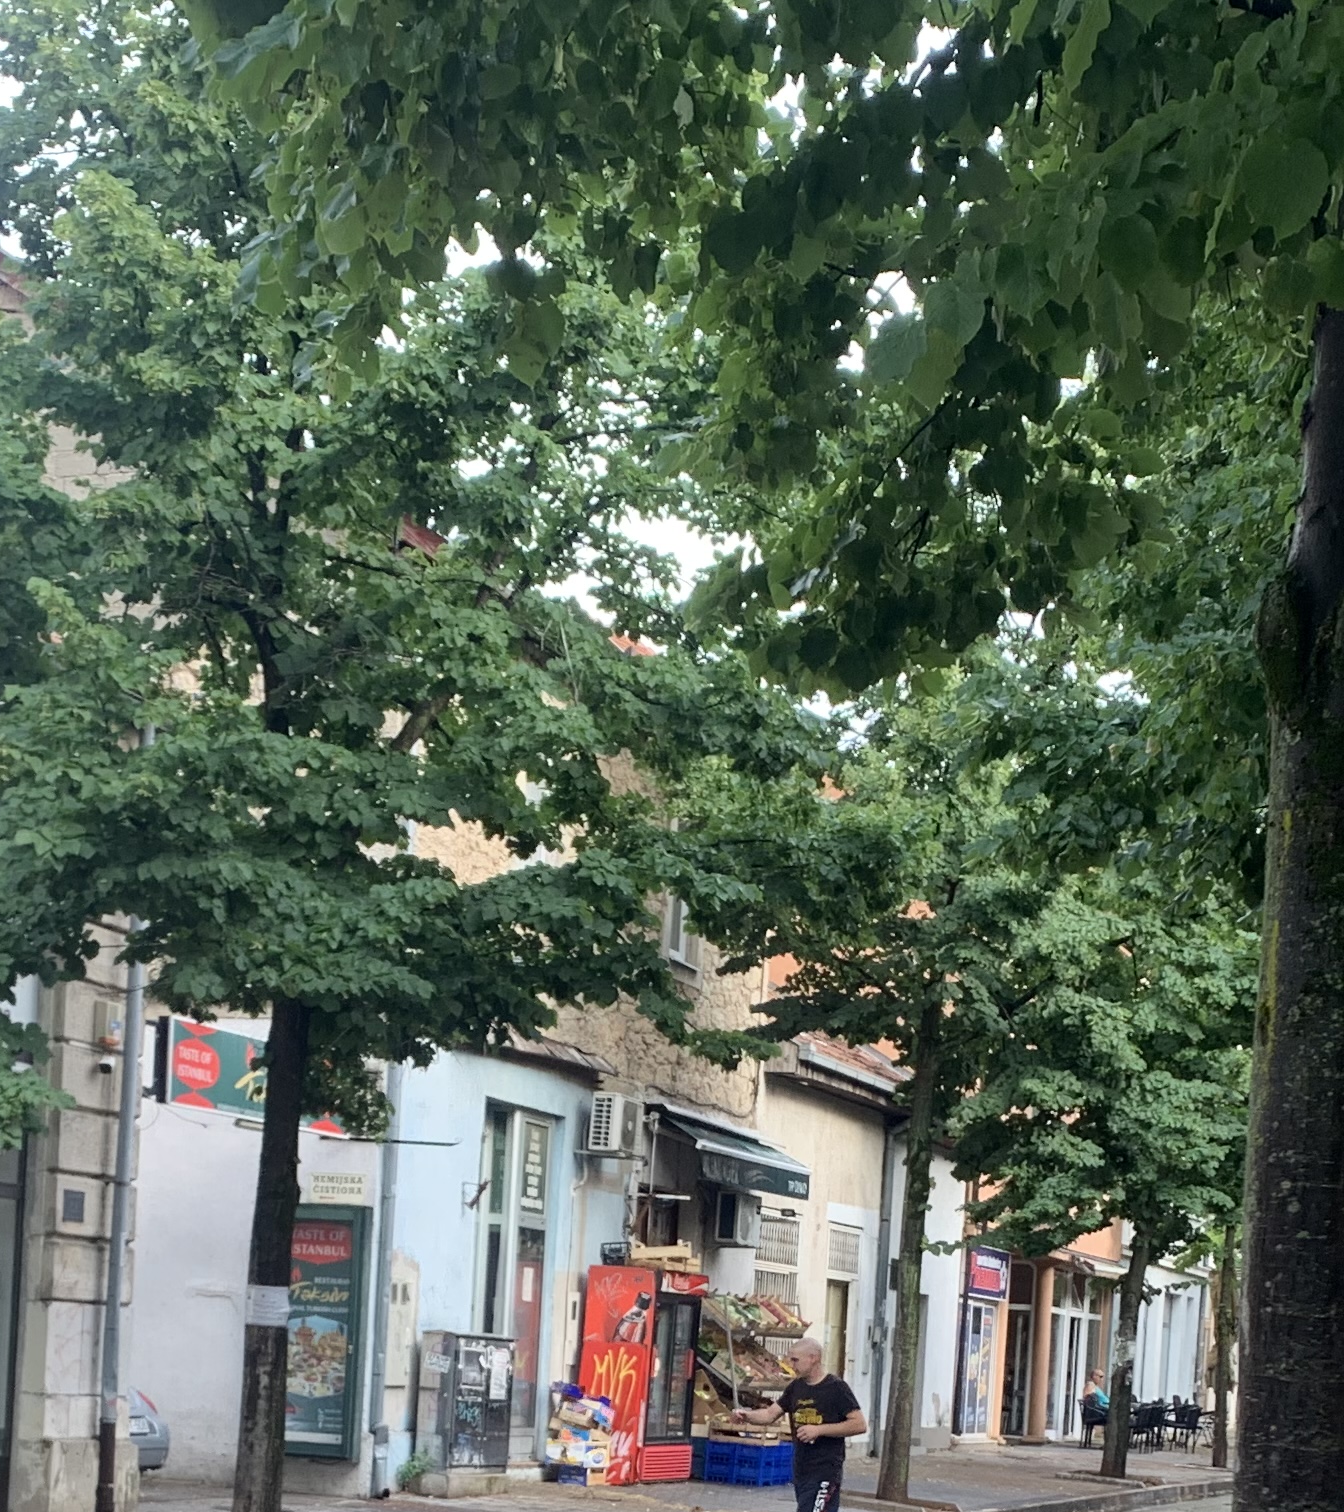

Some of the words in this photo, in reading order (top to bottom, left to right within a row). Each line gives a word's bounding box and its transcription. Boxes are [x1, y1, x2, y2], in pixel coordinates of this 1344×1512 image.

[178, 1045, 200, 1063] TASTE
[200, 1051, 212, 1065] OF
[177, 1063, 213, 1083] ISTANBUL
[329, 1230, 346, 1242] OF
[292, 1243, 347, 1257] STANBUL
